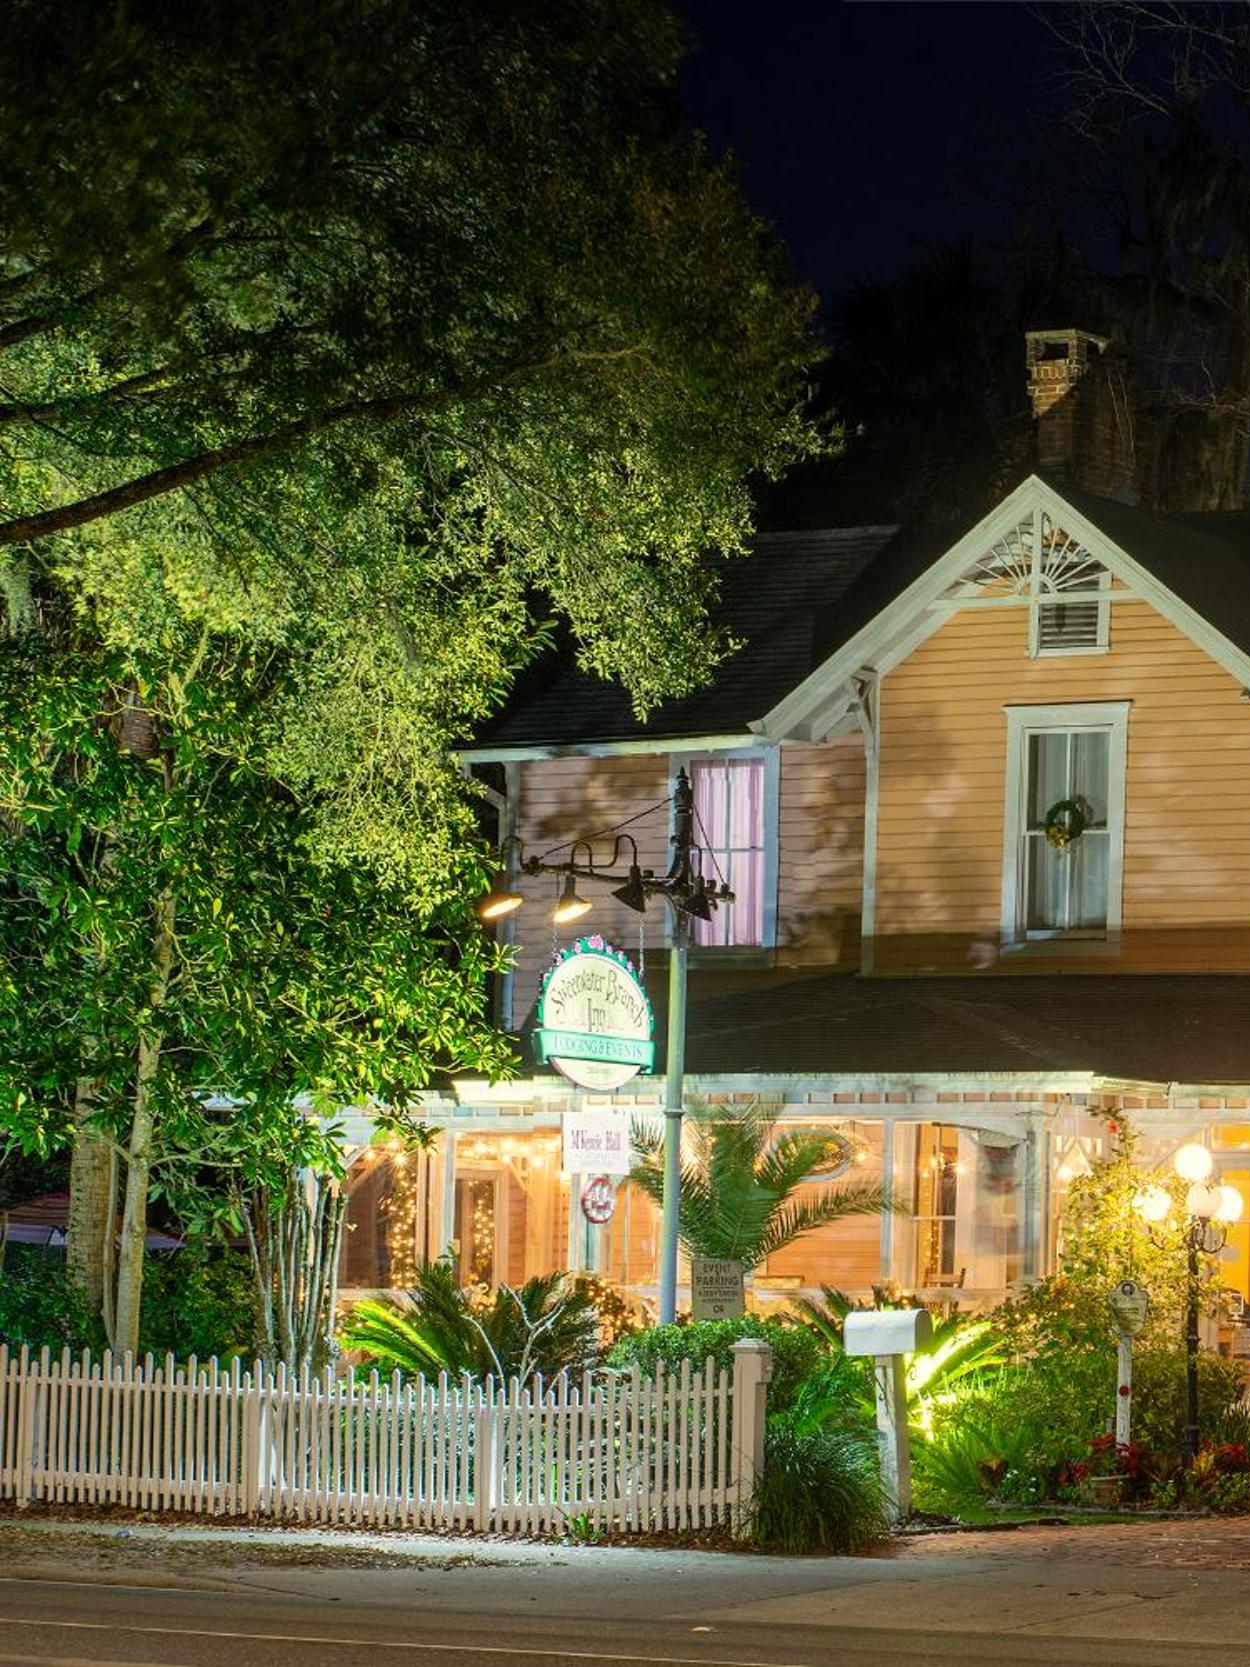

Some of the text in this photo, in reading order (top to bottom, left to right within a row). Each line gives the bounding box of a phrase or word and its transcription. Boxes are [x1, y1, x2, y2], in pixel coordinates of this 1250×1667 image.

[551, 969, 645, 1028] Sweetwater Branch
[587, 997, 606, 1032] Inn
[605, 1041, 643, 1059] EVENTS
[703, 1263, 731, 1272] EVENT
[696, 1276, 739, 1286] PARKING
